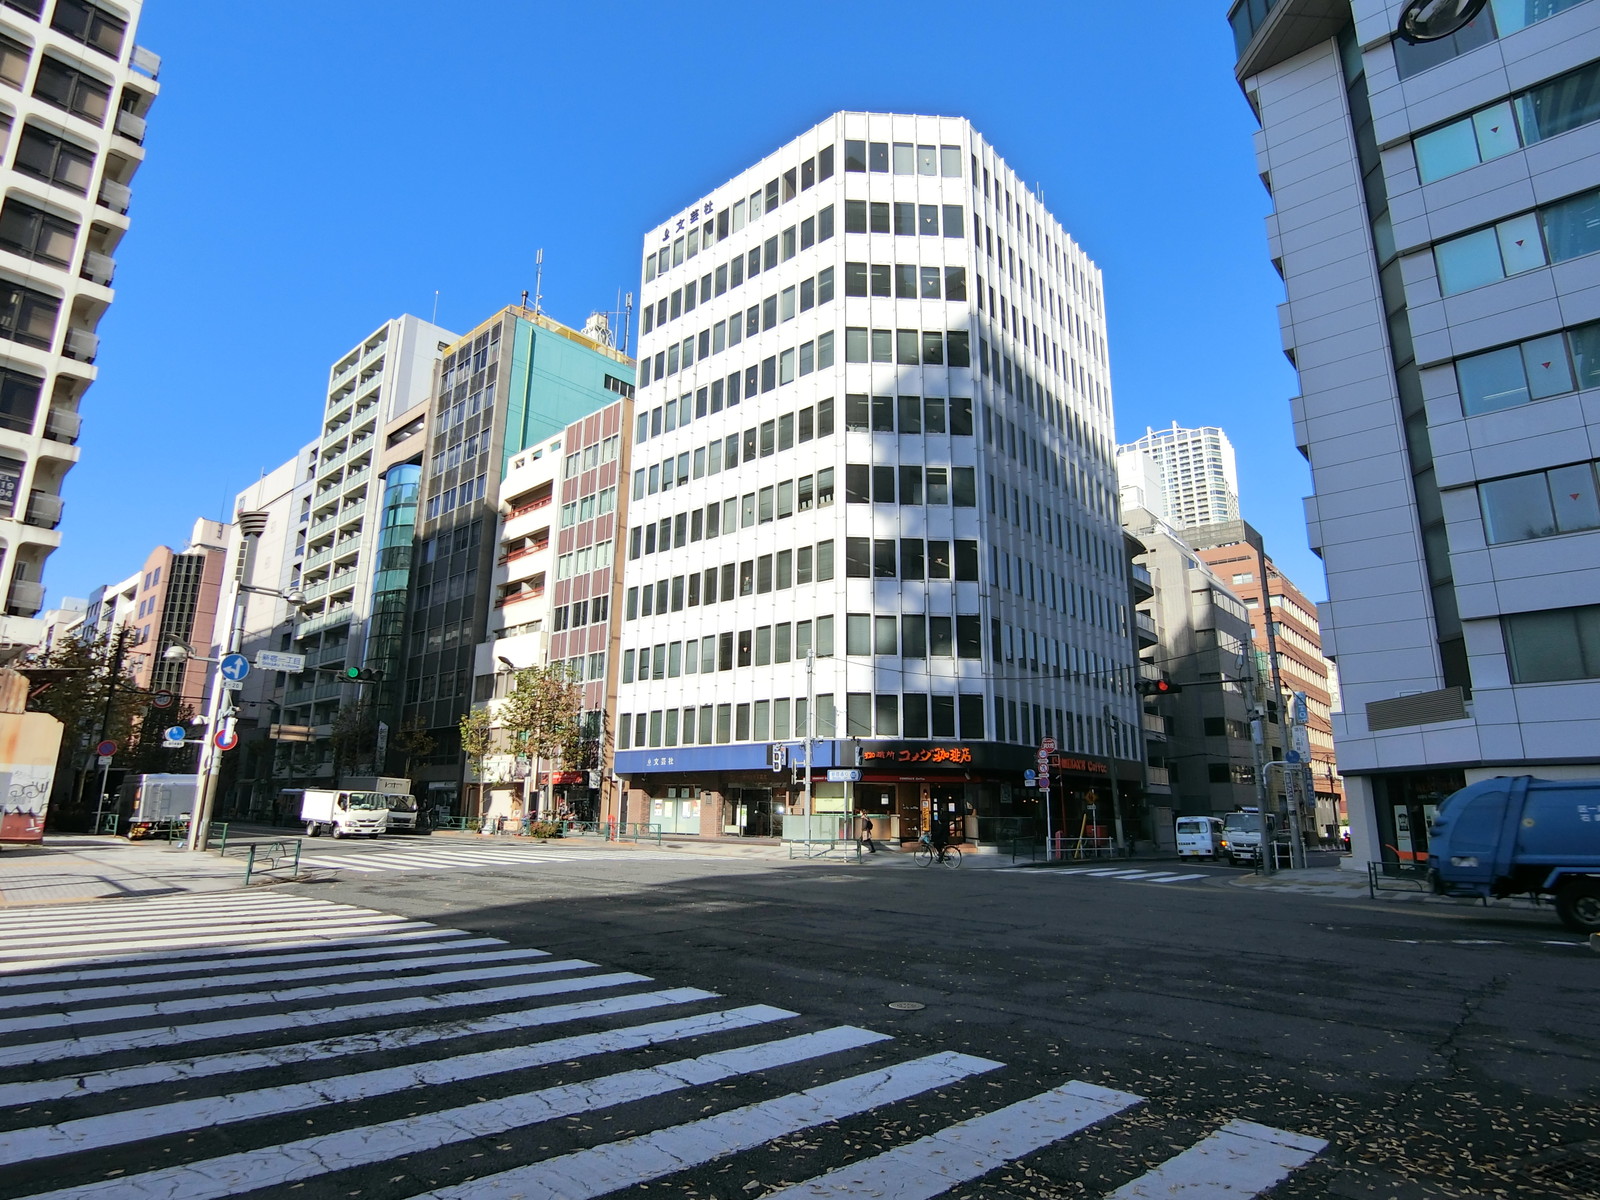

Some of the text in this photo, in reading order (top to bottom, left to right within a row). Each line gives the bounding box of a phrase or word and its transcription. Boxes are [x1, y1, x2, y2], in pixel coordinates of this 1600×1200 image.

[653, 757, 674, 766] 文芸社
[898, 747, 973, 764] コメダ珈琲店
